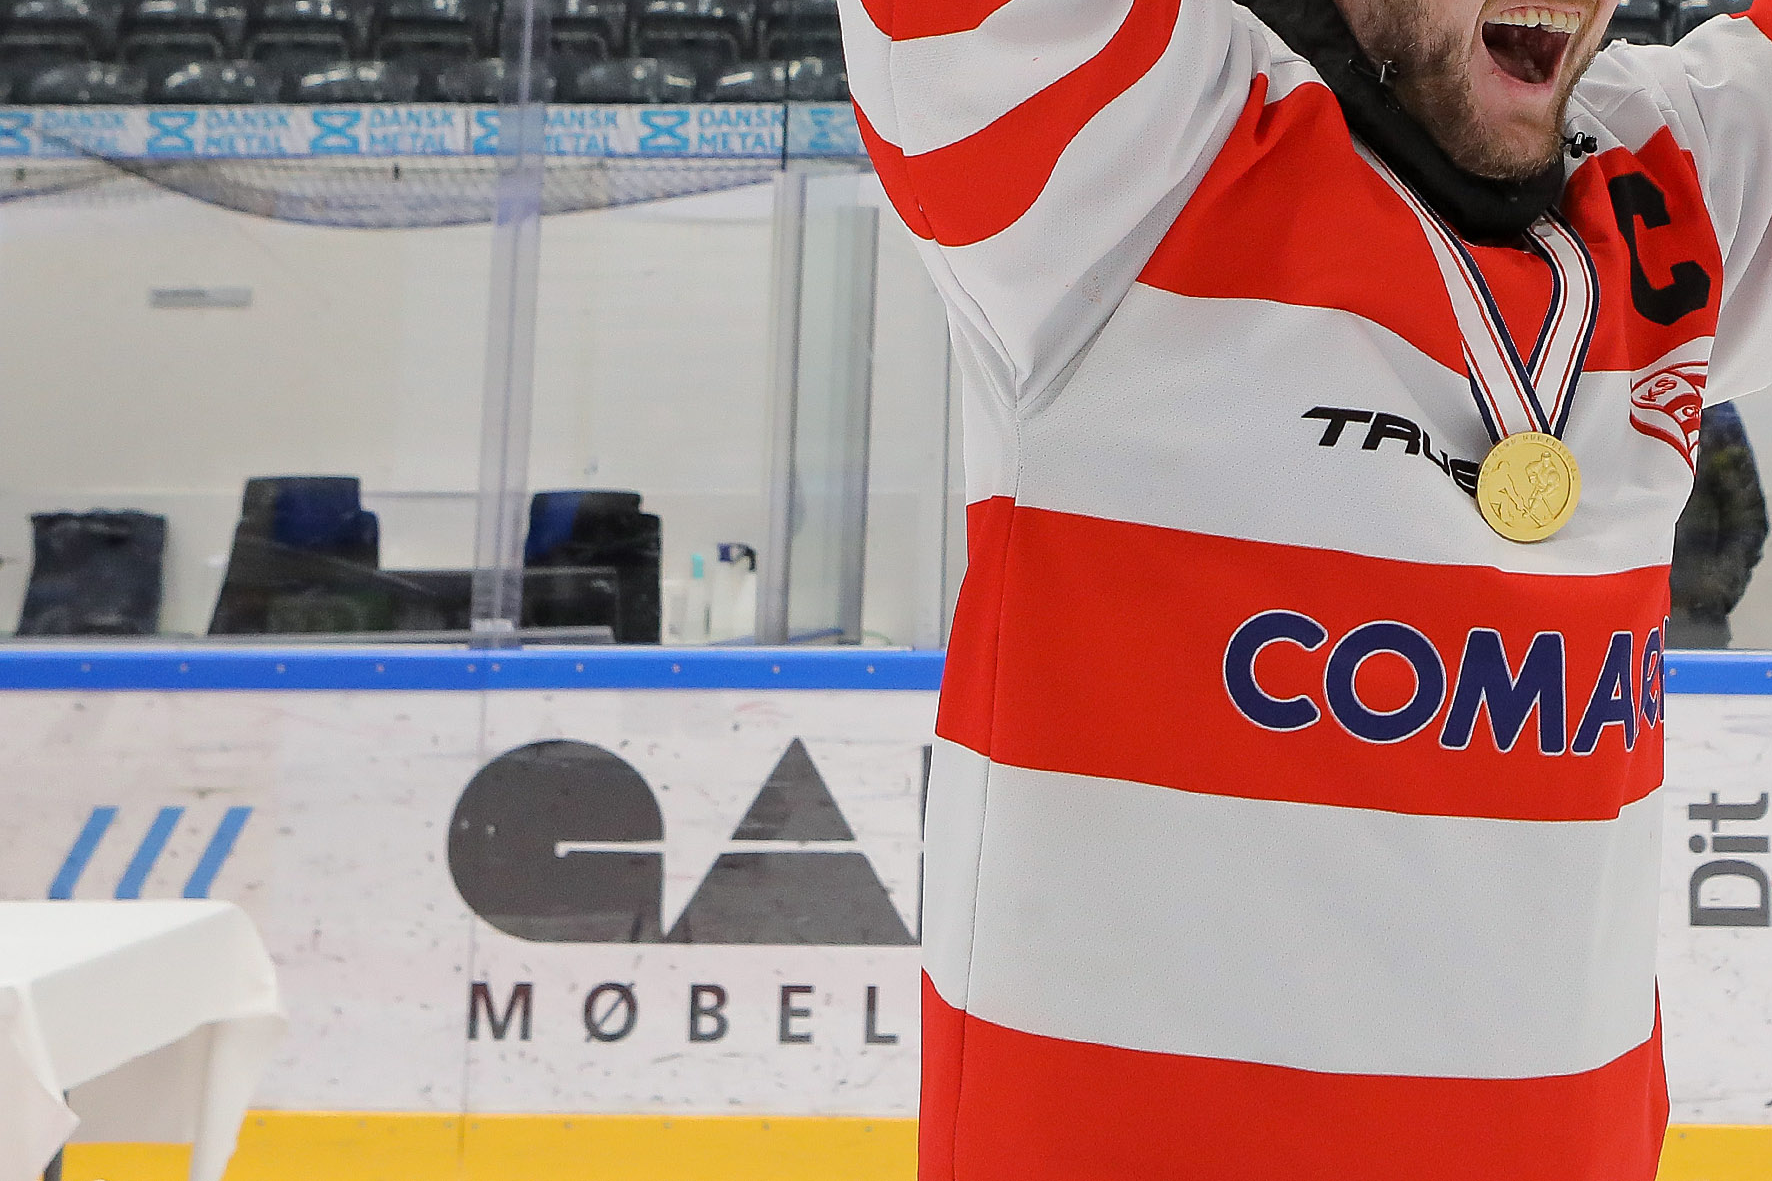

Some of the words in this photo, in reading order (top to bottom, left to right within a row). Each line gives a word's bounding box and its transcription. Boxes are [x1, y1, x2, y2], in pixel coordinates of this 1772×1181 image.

[1609, 171, 1710, 326] C
[1640, 376, 1678, 402] KS
[448, 737, 932, 947] GA
[1688, 791, 1772, 928] Dit
[466, 981, 899, 1046] MØBEL
